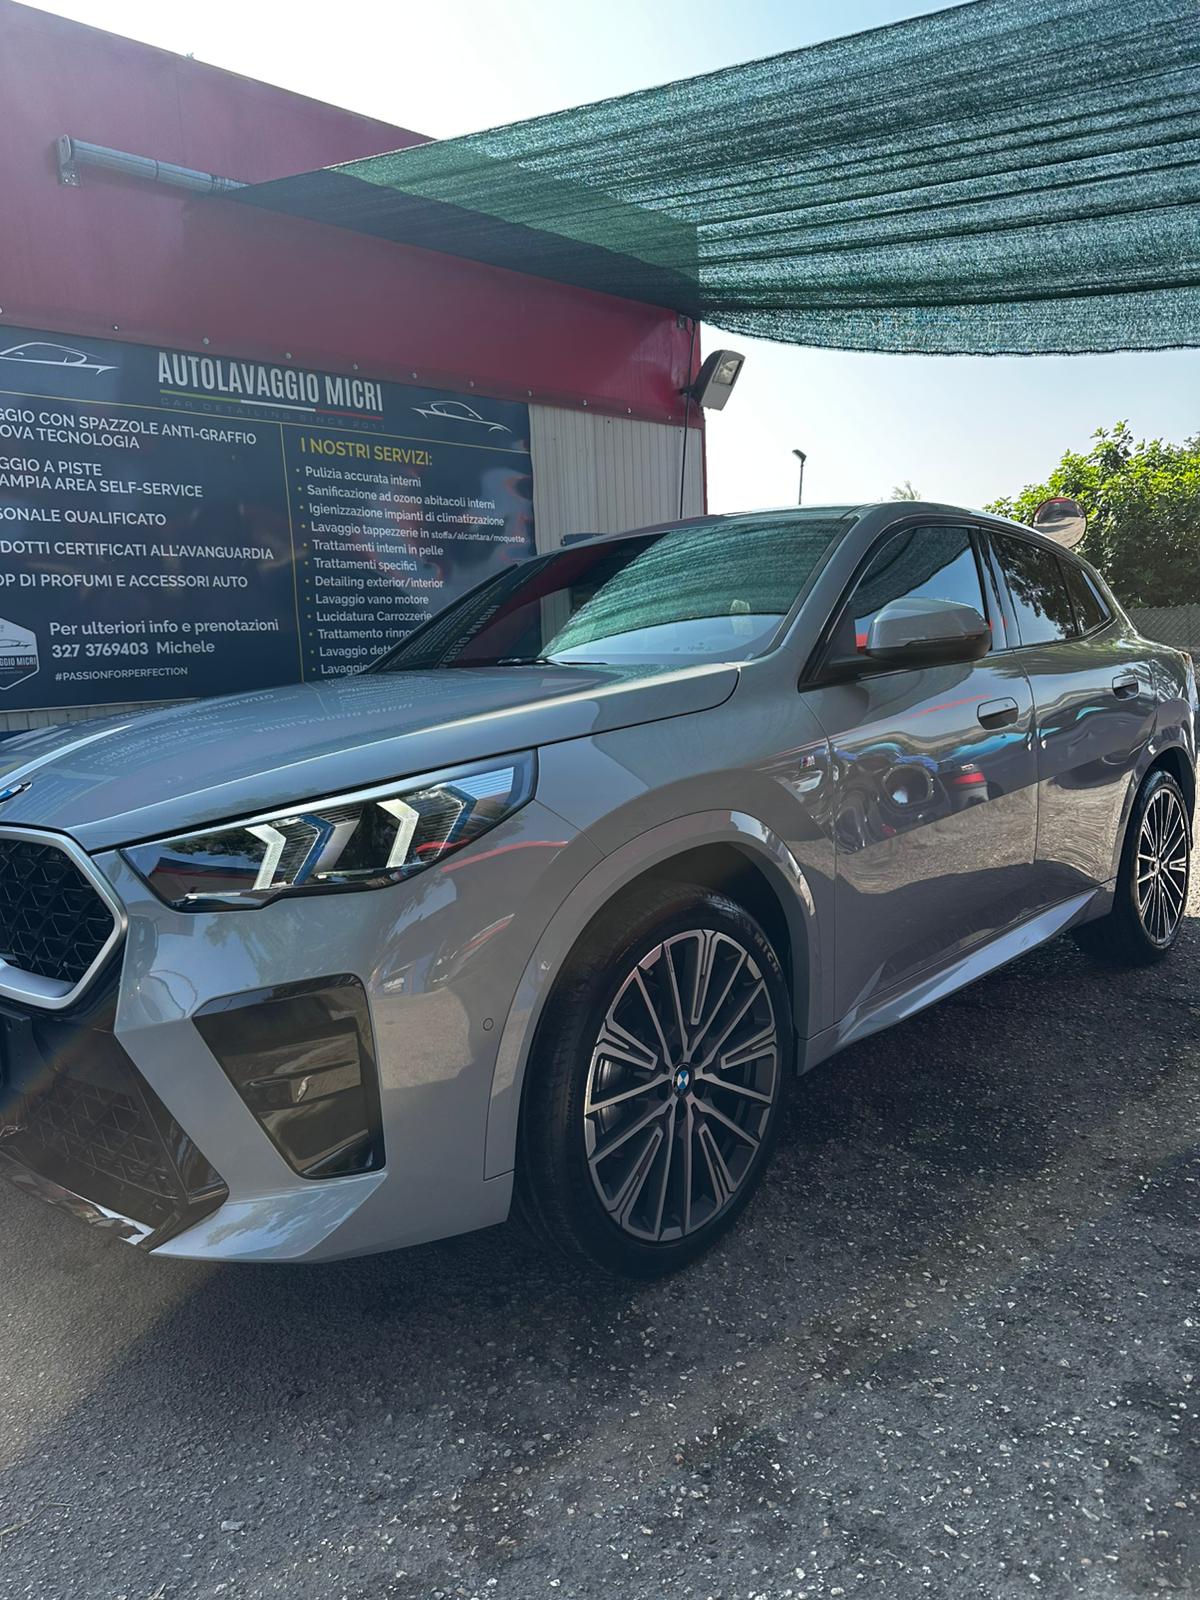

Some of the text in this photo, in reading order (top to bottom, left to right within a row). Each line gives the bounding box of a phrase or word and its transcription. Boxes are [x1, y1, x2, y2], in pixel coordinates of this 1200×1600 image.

[158, 352, 384, 411] AUTOLAVAGGIO MICRI
[0, 424, 140, 449] OVA TECNOLOGIA
[40, 412, 75, 428] CON
[79, 415, 158, 435] SPAZZOLE
[162, 426, 257, 445] ANTI-GRAFFIO
[301, 437, 433, 466] I NOSTRI SERVIZI:
[44, 460, 55, 472] A
[58, 460, 103, 476] PISTE
[305, 466, 421, 488] Pulizia accurata interni
[0, 473, 204, 498] AMPIA AREA SELF-SERVICE
[307, 485, 495, 510] Sanificazione ad ozono abitacoli interni
[64, 510, 167, 526] QUALIFICATO
[309, 504, 504, 526] Igienizzazione impianti di climatizzazione
[311, 521, 525, 544] Lavaggio tappezzerie in stoffa/alcantara/moquette
[0, 540, 274, 560] DOTTI CERTIFICATI ALL'AVANGUARDIA
[312, 540, 444, 558] Trattamenti interni in pelle
[314, 558, 417, 572] Trattamenti specifici
[20, 574, 36, 587] DI
[40, 574, 112, 588] PROFUMI
[117, 575, 126, 587] E
[129, 575, 209, 588] ACCESSORI
[212, 576, 248, 588] AUTO
[315, 576, 444, 589] Detailing exterior/interior
[315, 594, 429, 606] Lavaggio vano motore
[316, 611, 432, 622] Lucidatura Carrozzerie
[50, 618, 279, 640] Per ulteriori info e prenotazioni
[317, 629, 383, 639] Trattamento
[52, 640, 215, 658] 327 3769403 Michele
[320, 646, 368, 658] Lavaggio
[55, 666, 188, 681] #PASSIONFORPERFECTION
